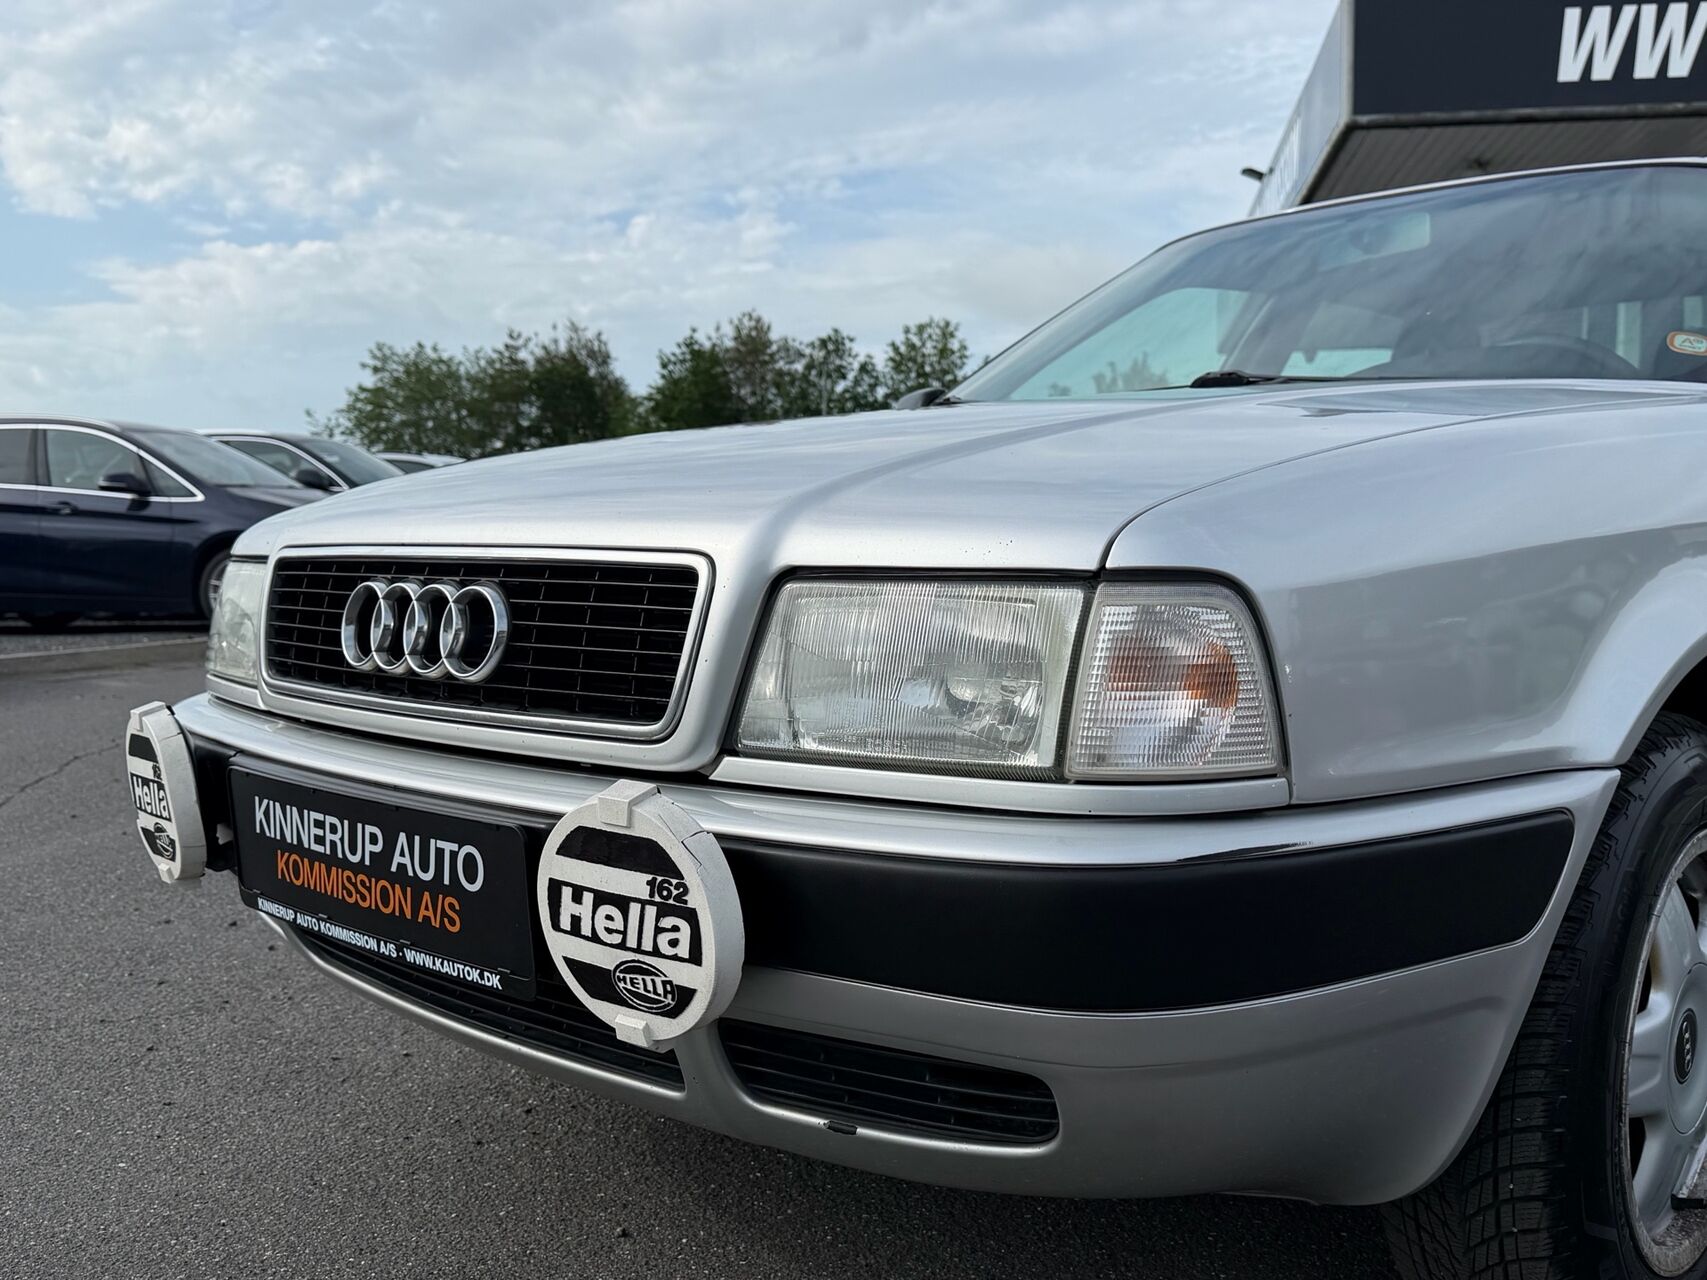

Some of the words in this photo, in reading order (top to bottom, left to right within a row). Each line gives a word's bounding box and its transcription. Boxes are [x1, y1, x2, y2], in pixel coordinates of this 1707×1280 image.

[134, 777, 169, 818] Hella
[255, 796, 383, 865] KINNERUP
[390, 831, 484, 892] AUTO
[277, 849, 412, 919] KOMMISSION
[418, 891, 461, 933] A/S
[559, 885, 691, 959] Hella
[646, 877, 689, 905] 162
[258, 897, 295, 922] KINNERUP
[296, 910, 319, 931] AUTO
[320, 920, 378, 952] KOMMISSION
[379, 941, 397, 958] A/S
[404, 947, 502, 989] WWW.KAUTOK.DK
[617, 973, 676, 1001] HELLA
